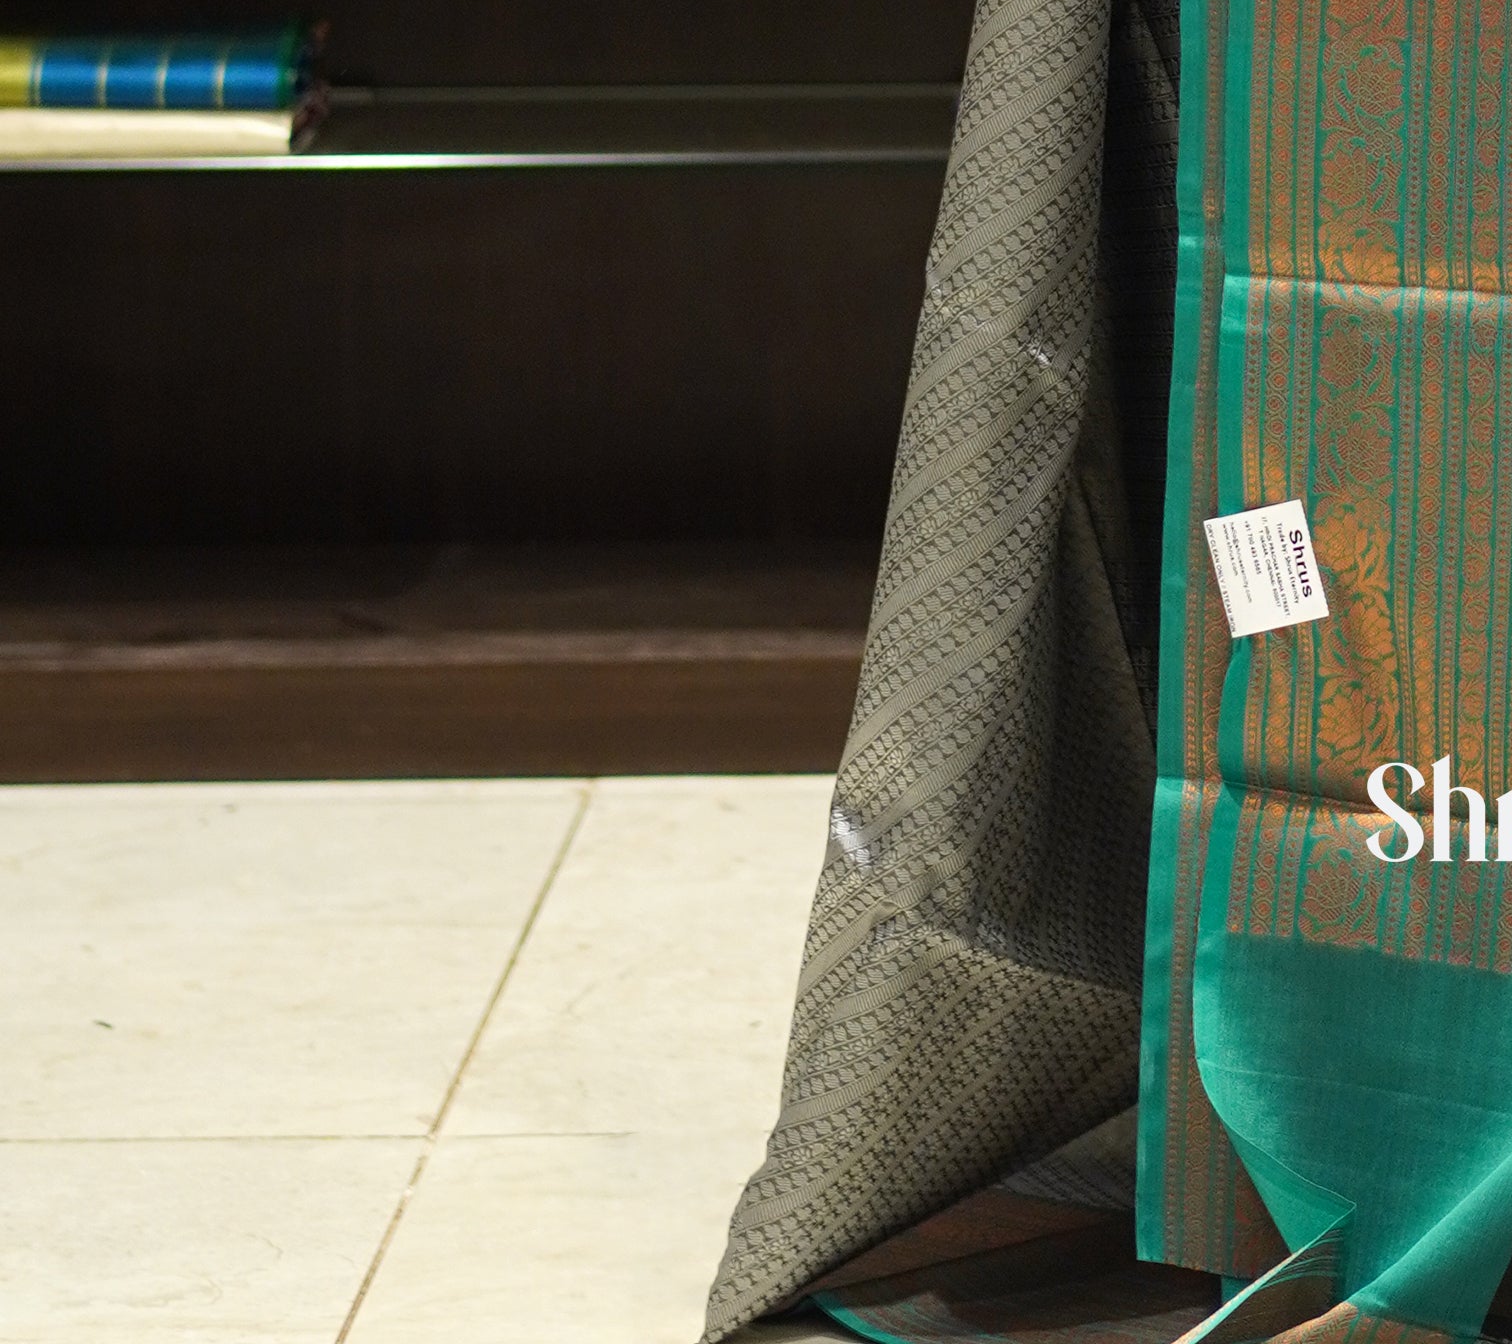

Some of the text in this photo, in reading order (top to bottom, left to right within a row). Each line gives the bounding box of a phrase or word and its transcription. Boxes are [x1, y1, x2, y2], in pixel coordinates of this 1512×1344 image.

[1276, 522, 1300, 603] Trade by: Shrus Eternity
[1289, 529, 1312, 597] Shrus
